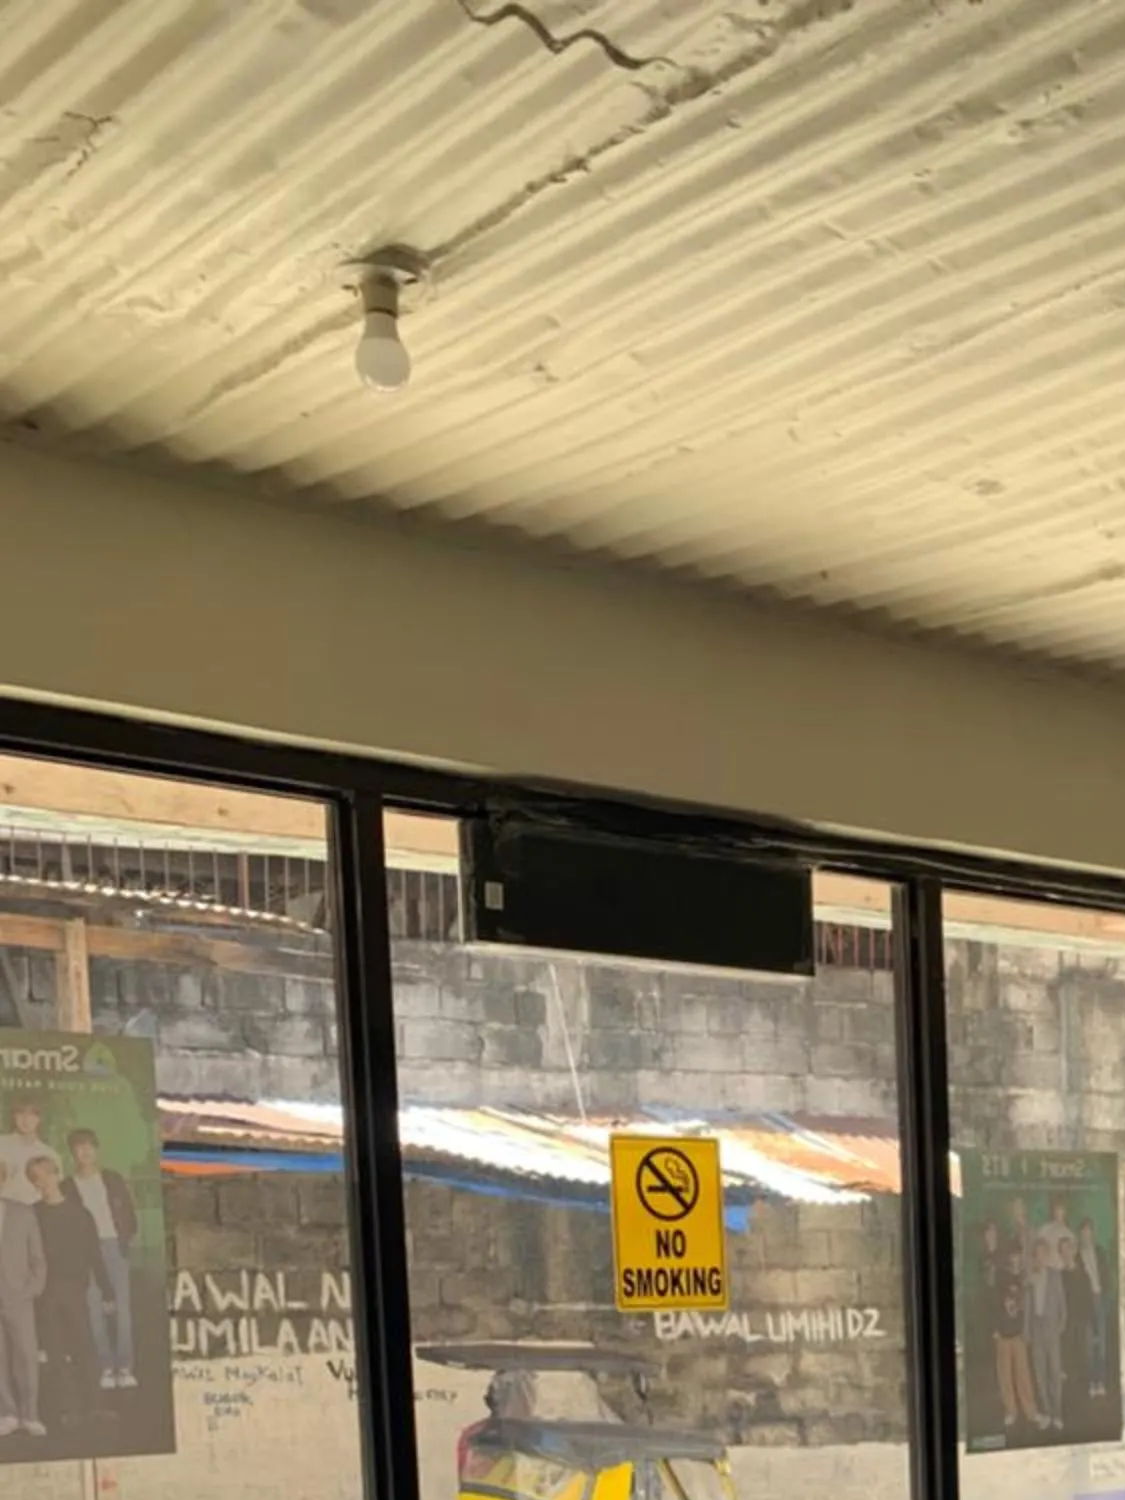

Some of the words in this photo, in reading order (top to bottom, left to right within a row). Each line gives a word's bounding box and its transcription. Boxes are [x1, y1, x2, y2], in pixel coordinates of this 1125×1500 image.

[655, 1229, 687, 1259] NO
[169, 1269, 308, 1312] AWAL
[622, 1267, 722, 1298] SMOKING
[653, 1311, 766, 1342] BAWAL
